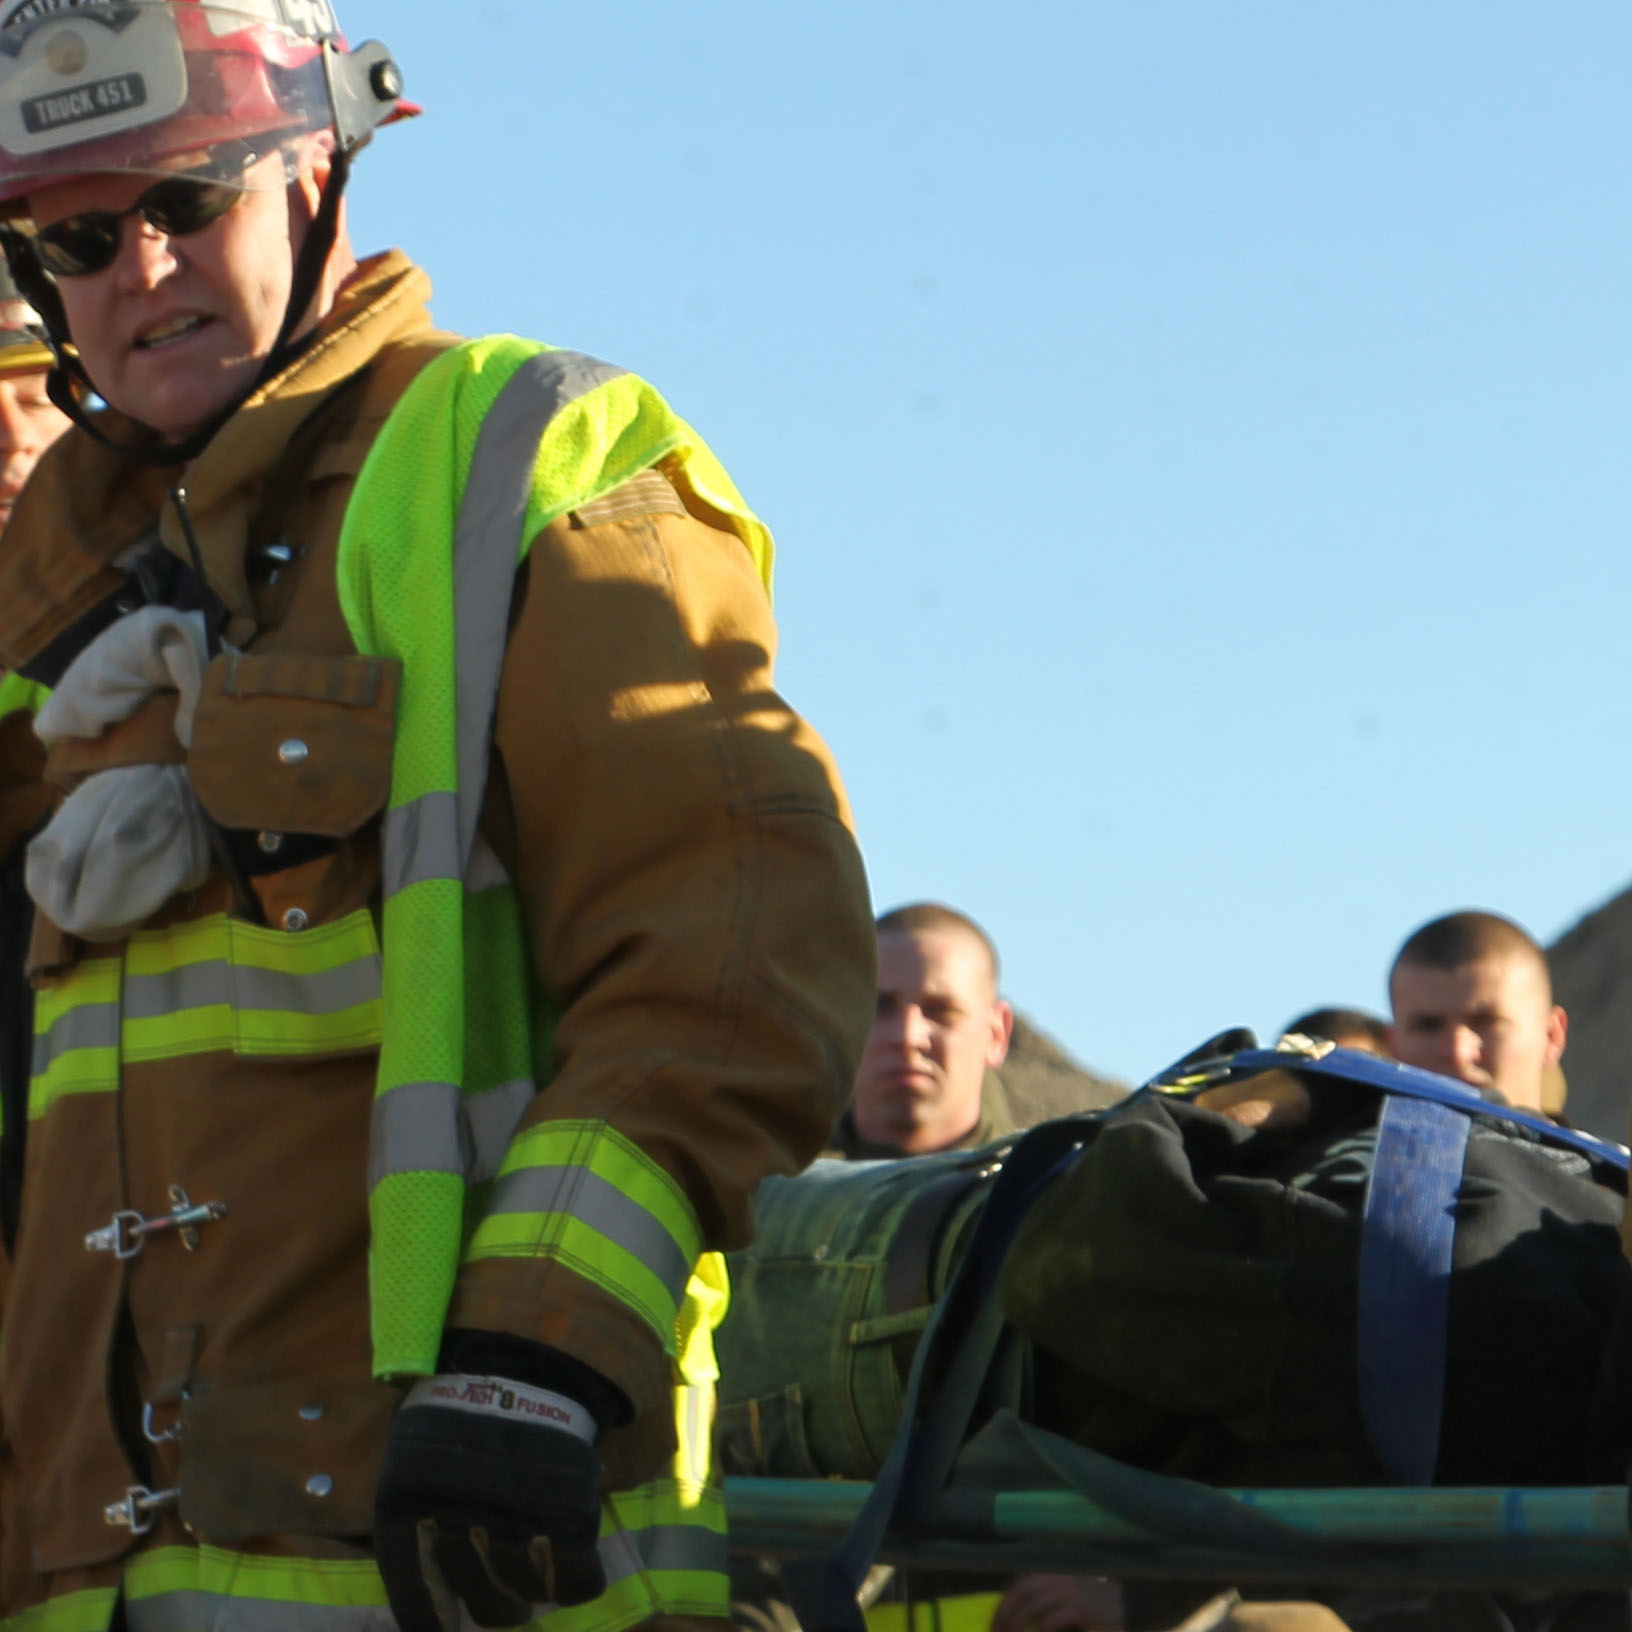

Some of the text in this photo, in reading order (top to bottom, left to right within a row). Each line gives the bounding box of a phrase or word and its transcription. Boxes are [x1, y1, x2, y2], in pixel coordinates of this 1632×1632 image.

[36, 79, 134, 124] TRUCK 451
[517, 1397, 573, 1424] FUSION
